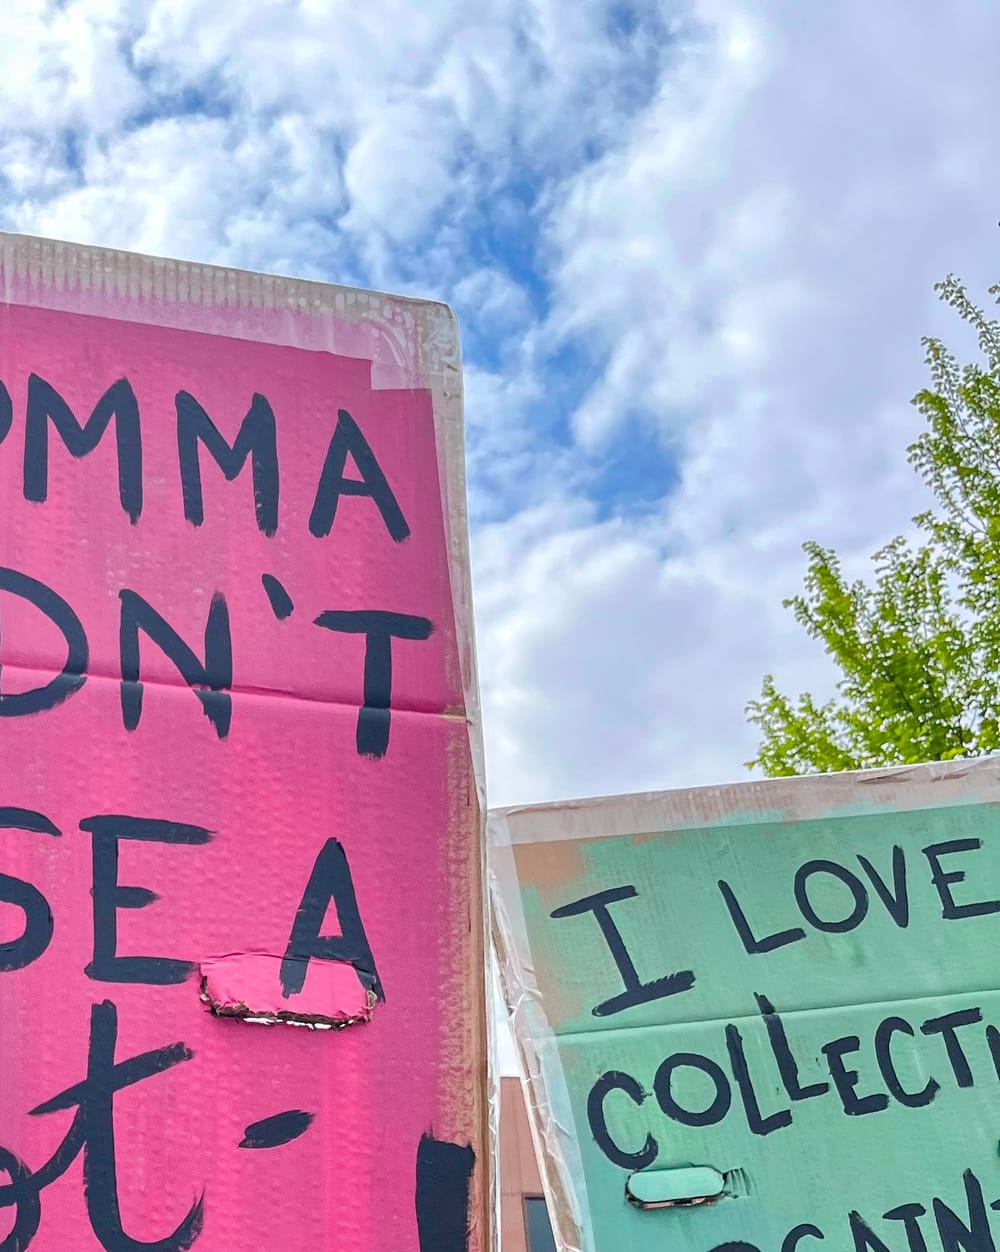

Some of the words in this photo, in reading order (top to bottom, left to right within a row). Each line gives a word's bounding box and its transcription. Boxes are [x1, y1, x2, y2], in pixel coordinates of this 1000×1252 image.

[280, 836, 386, 1002] A
[549, 884, 696, 1017] I
[717, 838, 1000, 957] LOVE
